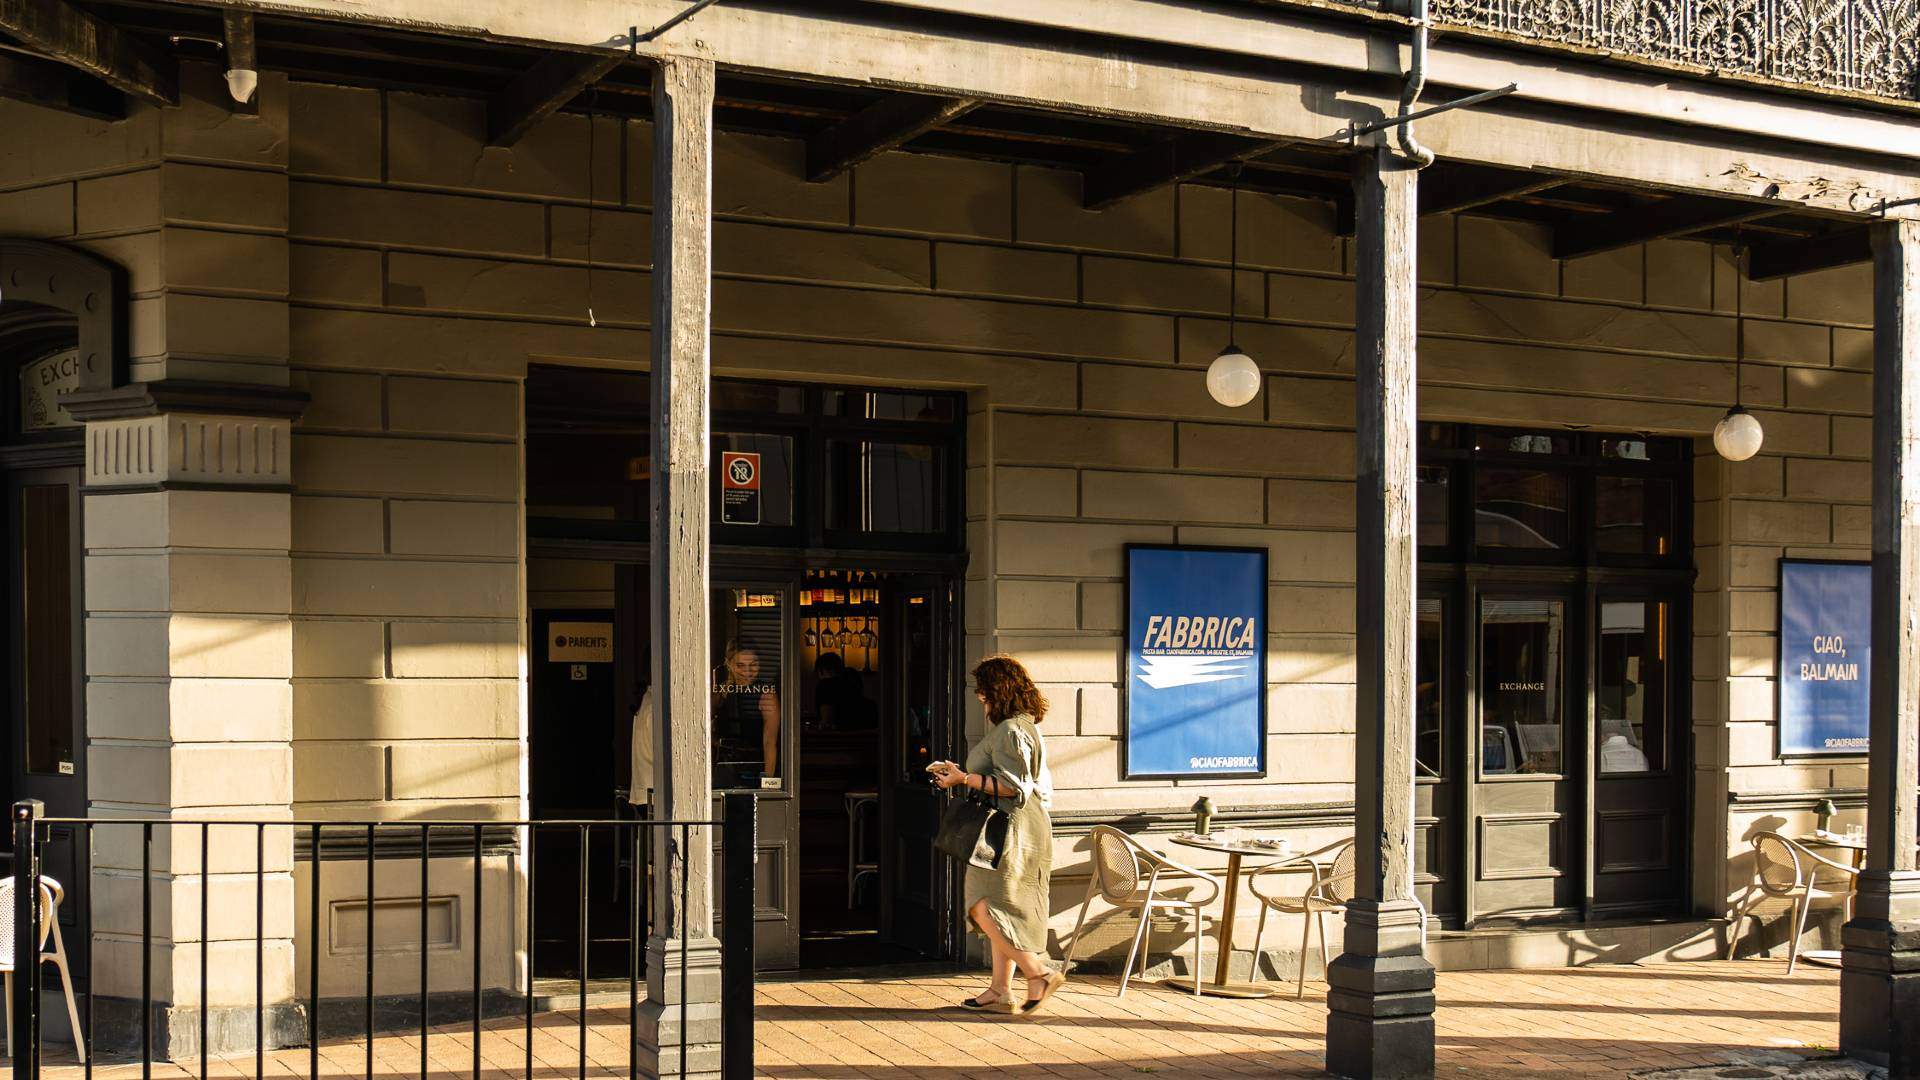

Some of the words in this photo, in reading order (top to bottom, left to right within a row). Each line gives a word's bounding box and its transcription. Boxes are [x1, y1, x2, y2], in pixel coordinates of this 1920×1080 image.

[1143, 615, 1255, 648] FABBRICA
[568, 636, 608, 648] PARENTS
[1813, 635, 1846, 658] CIAO,
[1801, 663, 1858, 680] BALMAIN
[712, 684, 776, 694] EXCHANGE
[1499, 682, 1544, 691] EXCHANGE
[1190, 756, 1258, 769] @CIAOFABBRICA
